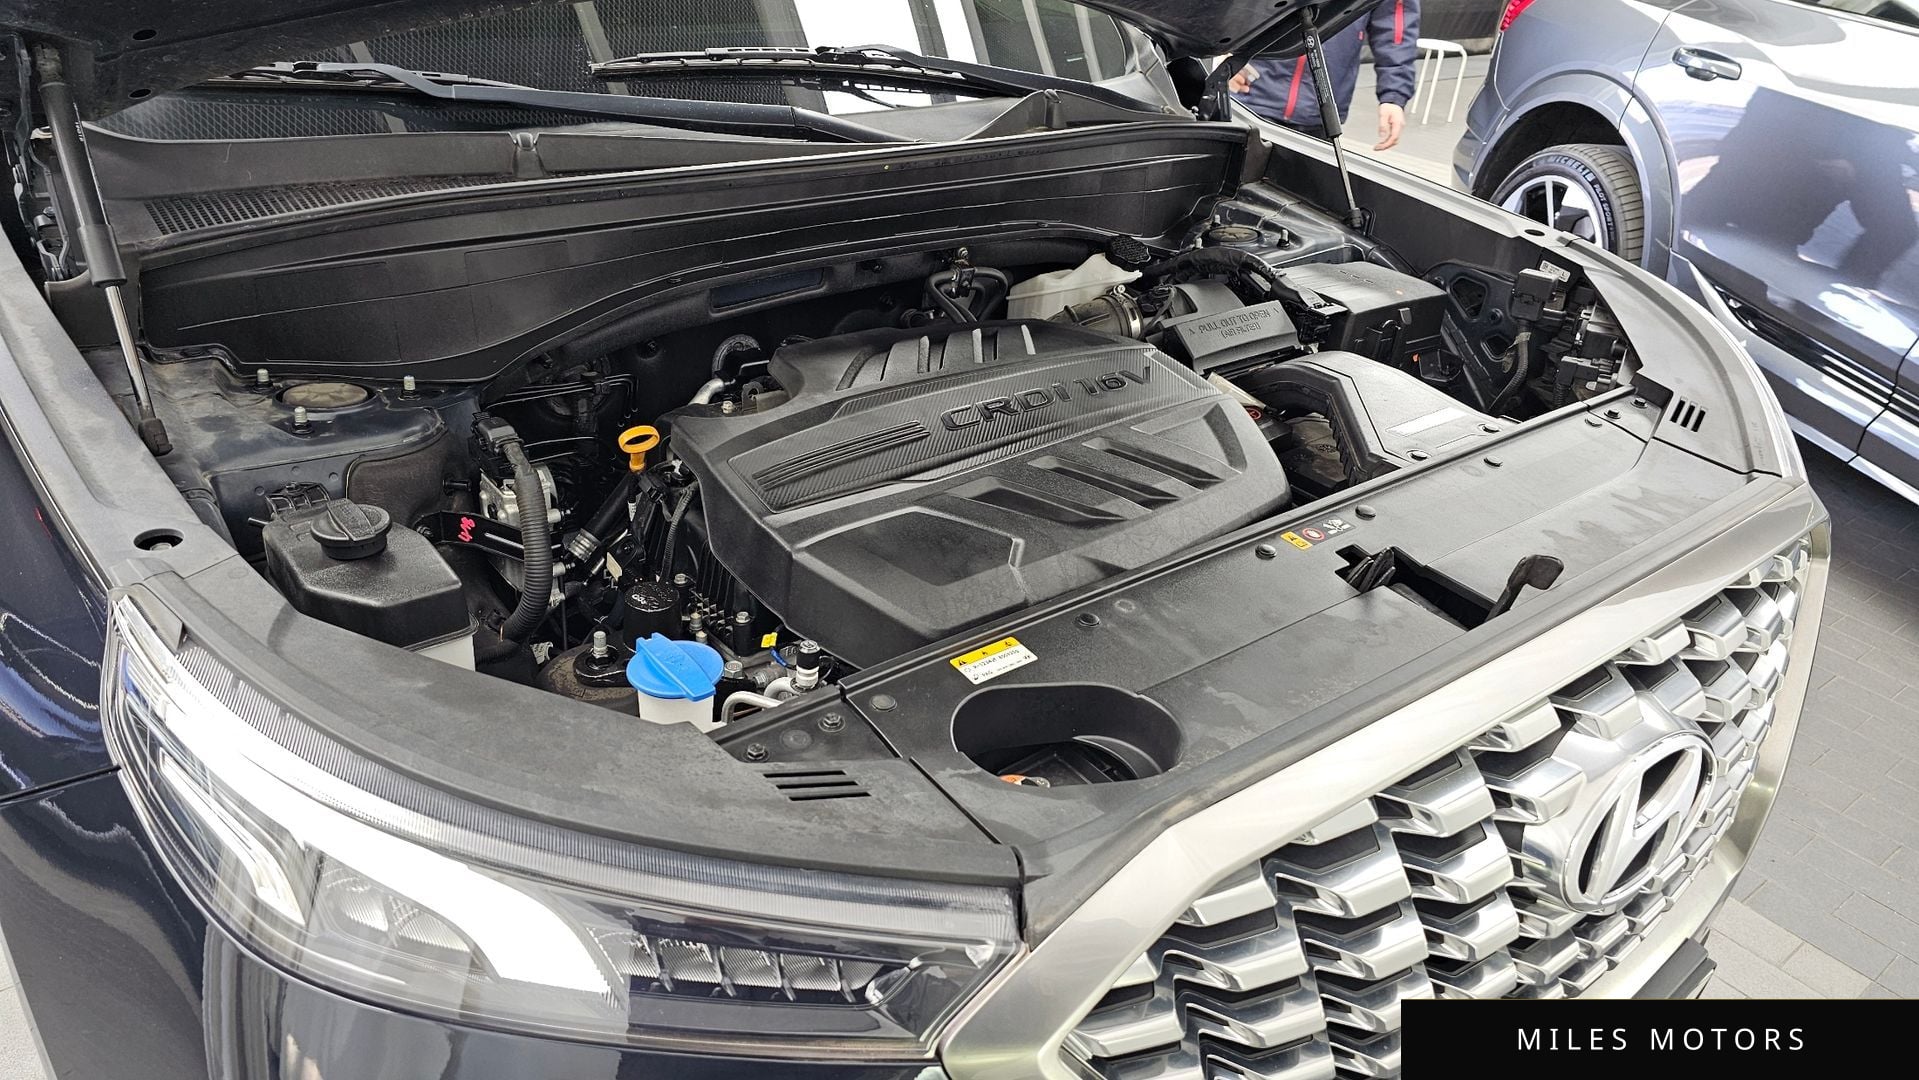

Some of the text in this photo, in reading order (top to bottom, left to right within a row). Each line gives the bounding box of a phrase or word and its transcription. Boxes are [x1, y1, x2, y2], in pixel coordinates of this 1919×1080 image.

[1547, 155, 1596, 182] MICHELIN
[1594, 184, 1607, 202] PILOT
[1602, 202, 1613, 227] SPORT
[1199, 309, 1271, 333] PULL OUT TO OPEN
[1073, 366, 1151, 396] 16V
